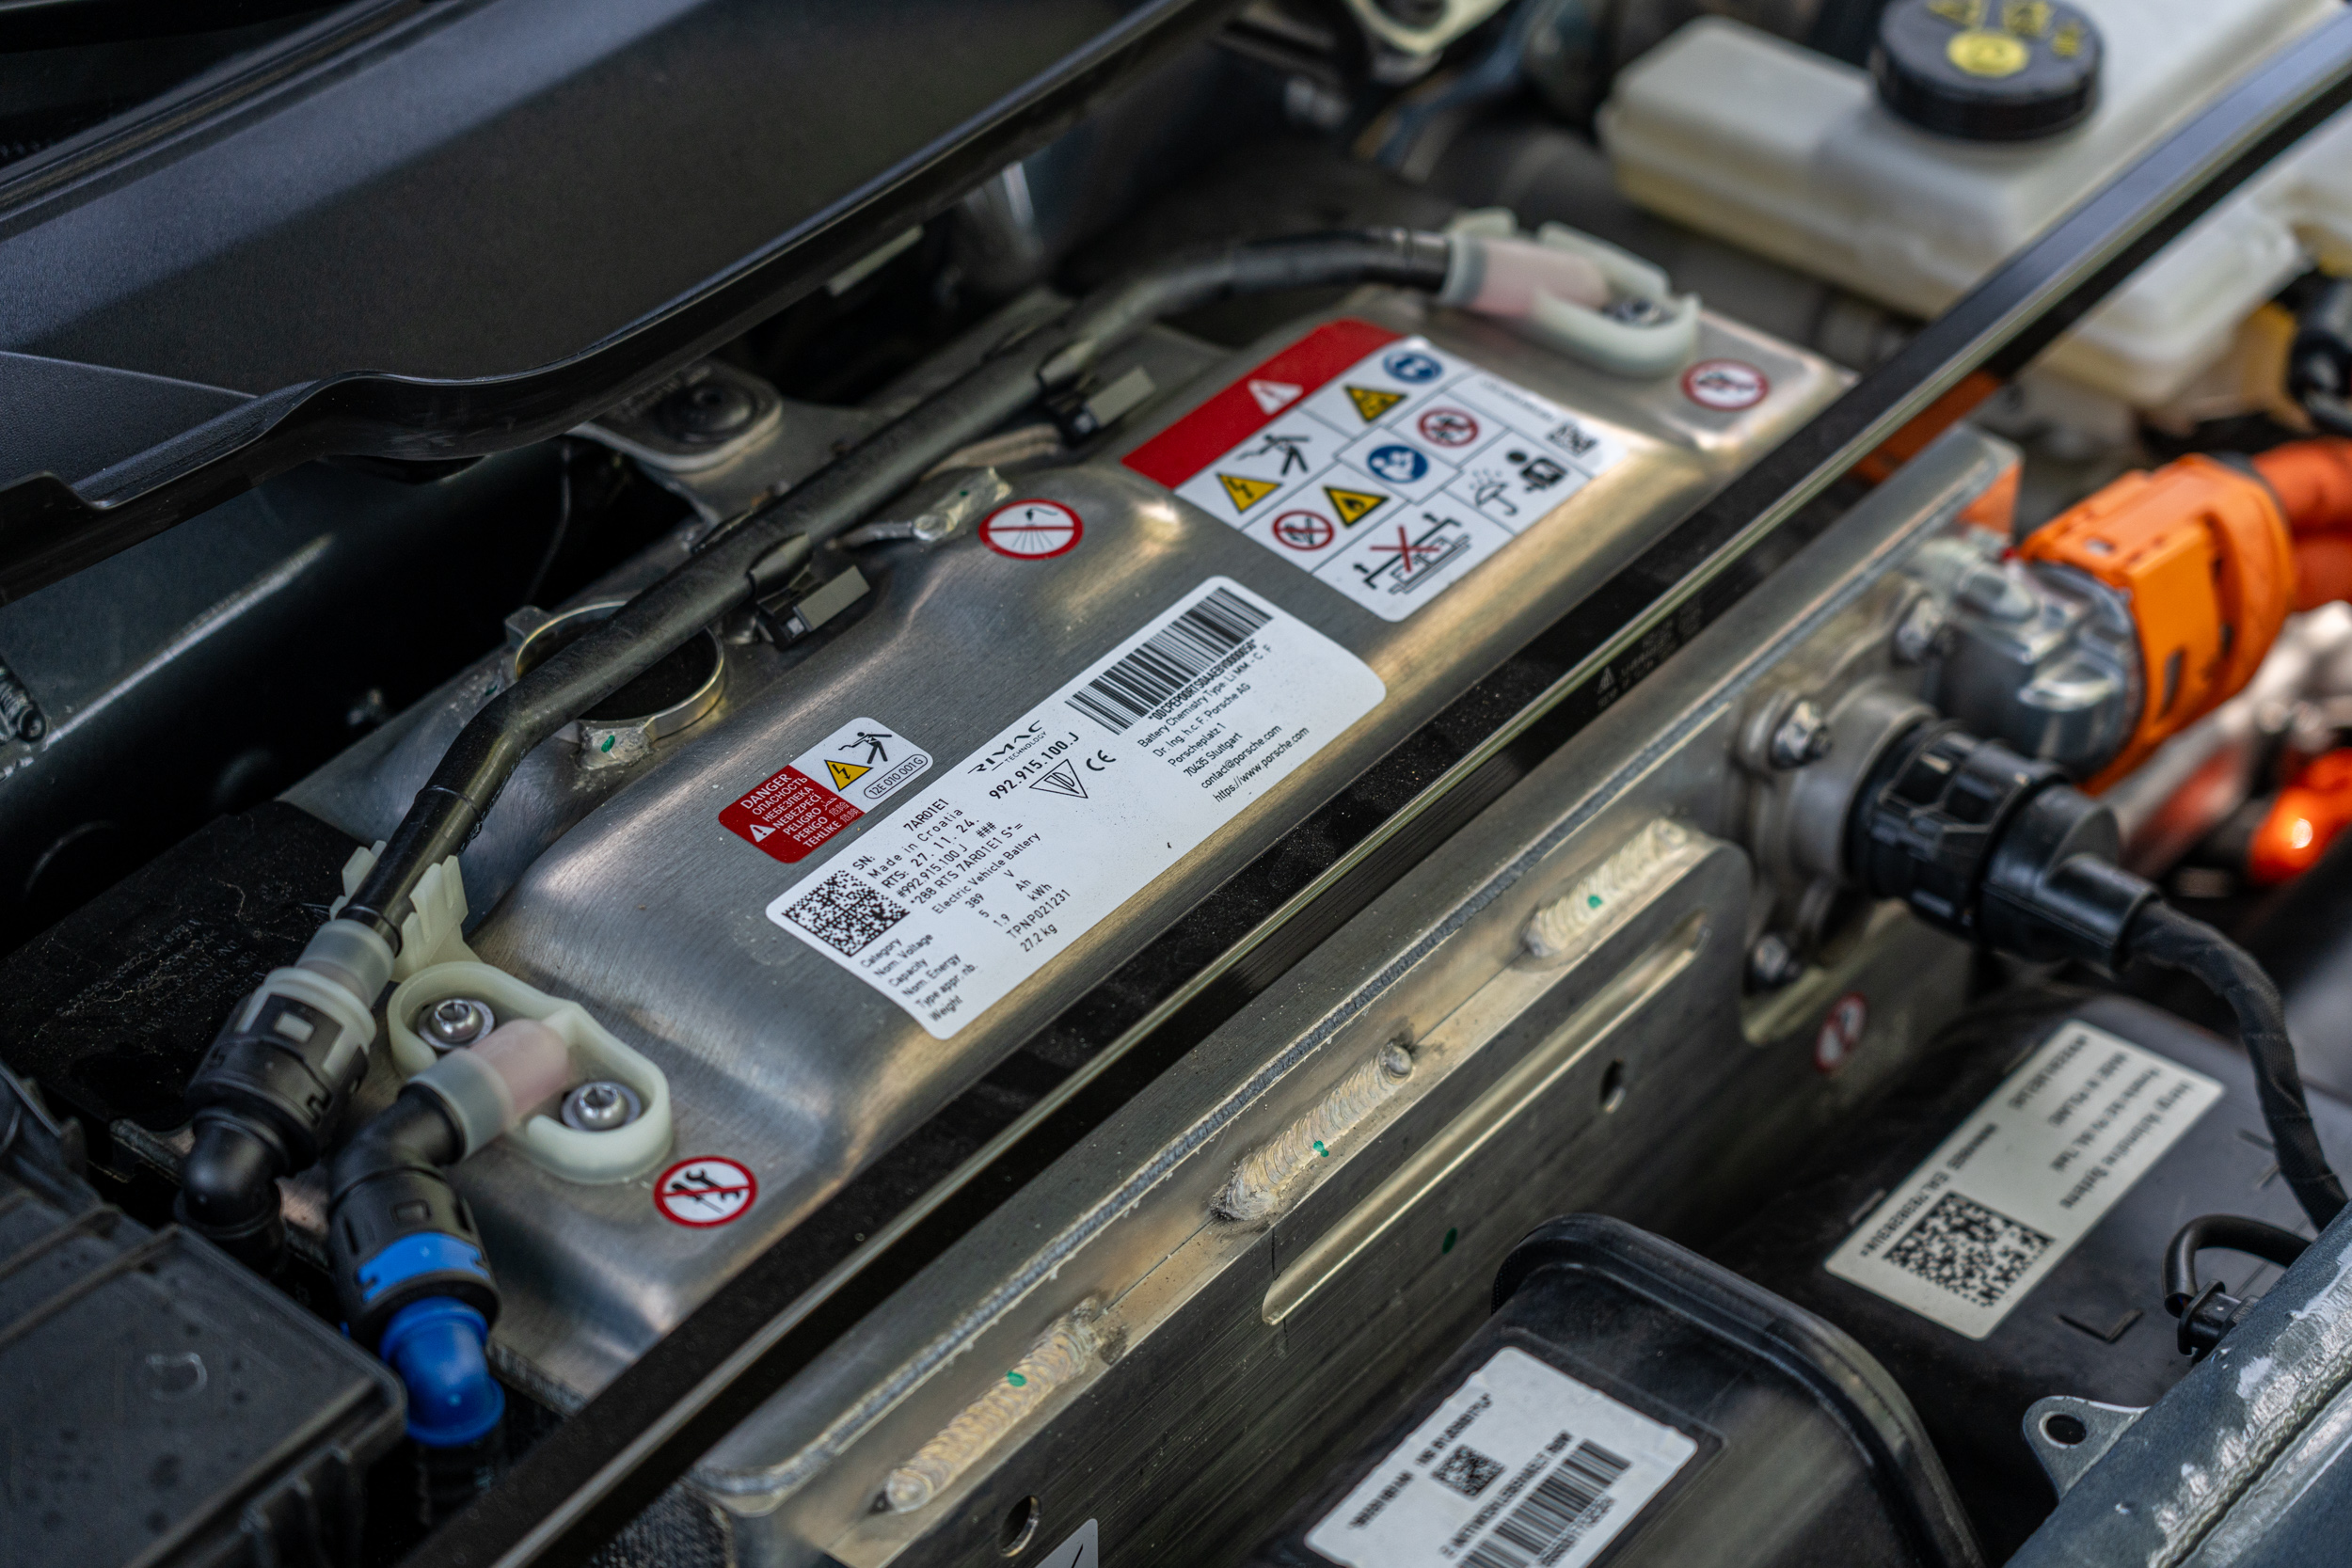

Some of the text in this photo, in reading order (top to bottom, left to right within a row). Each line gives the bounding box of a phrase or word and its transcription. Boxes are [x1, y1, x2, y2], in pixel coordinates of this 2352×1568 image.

[967, 720, 1042, 774] RIMAC
[1004, 731, 1046, 763] TECHNOLOGY
[1136, 724, 1170, 748] Battery
[1165, 696, 1209, 726] Chemistry
[1152, 683, 1251, 757] Dr. Ing. h.c. F. Porsche AG
[989, 732, 1079, 800] 992.915.100.J
[1168, 728, 1221, 767] Porscheplatz
[1183, 732, 1243, 777] 70435 Stuttgart
[1200, 725, 1281, 788] contact@porsche.com
[1212, 728, 1310, 802] https://www.porsche.com
[740, 773, 792, 809] DANGER
[752, 777, 808, 815] ОПАСНОСТЬ
[762, 786, 814, 822] НЕБЕЗПЕКА
[772, 792, 822, 829] NEBEZPEČÍ
[868, 783, 886, 796] 12E
[882, 772, 901, 786] 010
[783, 807, 821, 835] PELIGRO
[792, 816, 828, 842] PERIGO
[852, 799, 948, 870] SN: 7AR01E1
[867, 809, 963, 879] Made in Croatia
[881, 870, 909, 889] RTS:
[897, 850, 960, 897] #992.915.100
[976, 822, 996, 838] ###
[934, 870, 959, 888] RTS
[956, 837, 1003, 872] 7AR01E1
[860, 833, 1041, 968] Category Electric Vehicle Battery
[873, 869, 1014, 976] Nom. Voltage 389 V
[888, 879, 1031, 987] Capacity 5 Ah
[901, 884, 1052, 995] Nom. Energy 1.9 kWh
[915, 991, 940, 1006] Type
[1006, 889, 1071, 938] TPNP021231
[930, 995, 962, 1022] Weight
[1040, 924, 1057, 936] kg
